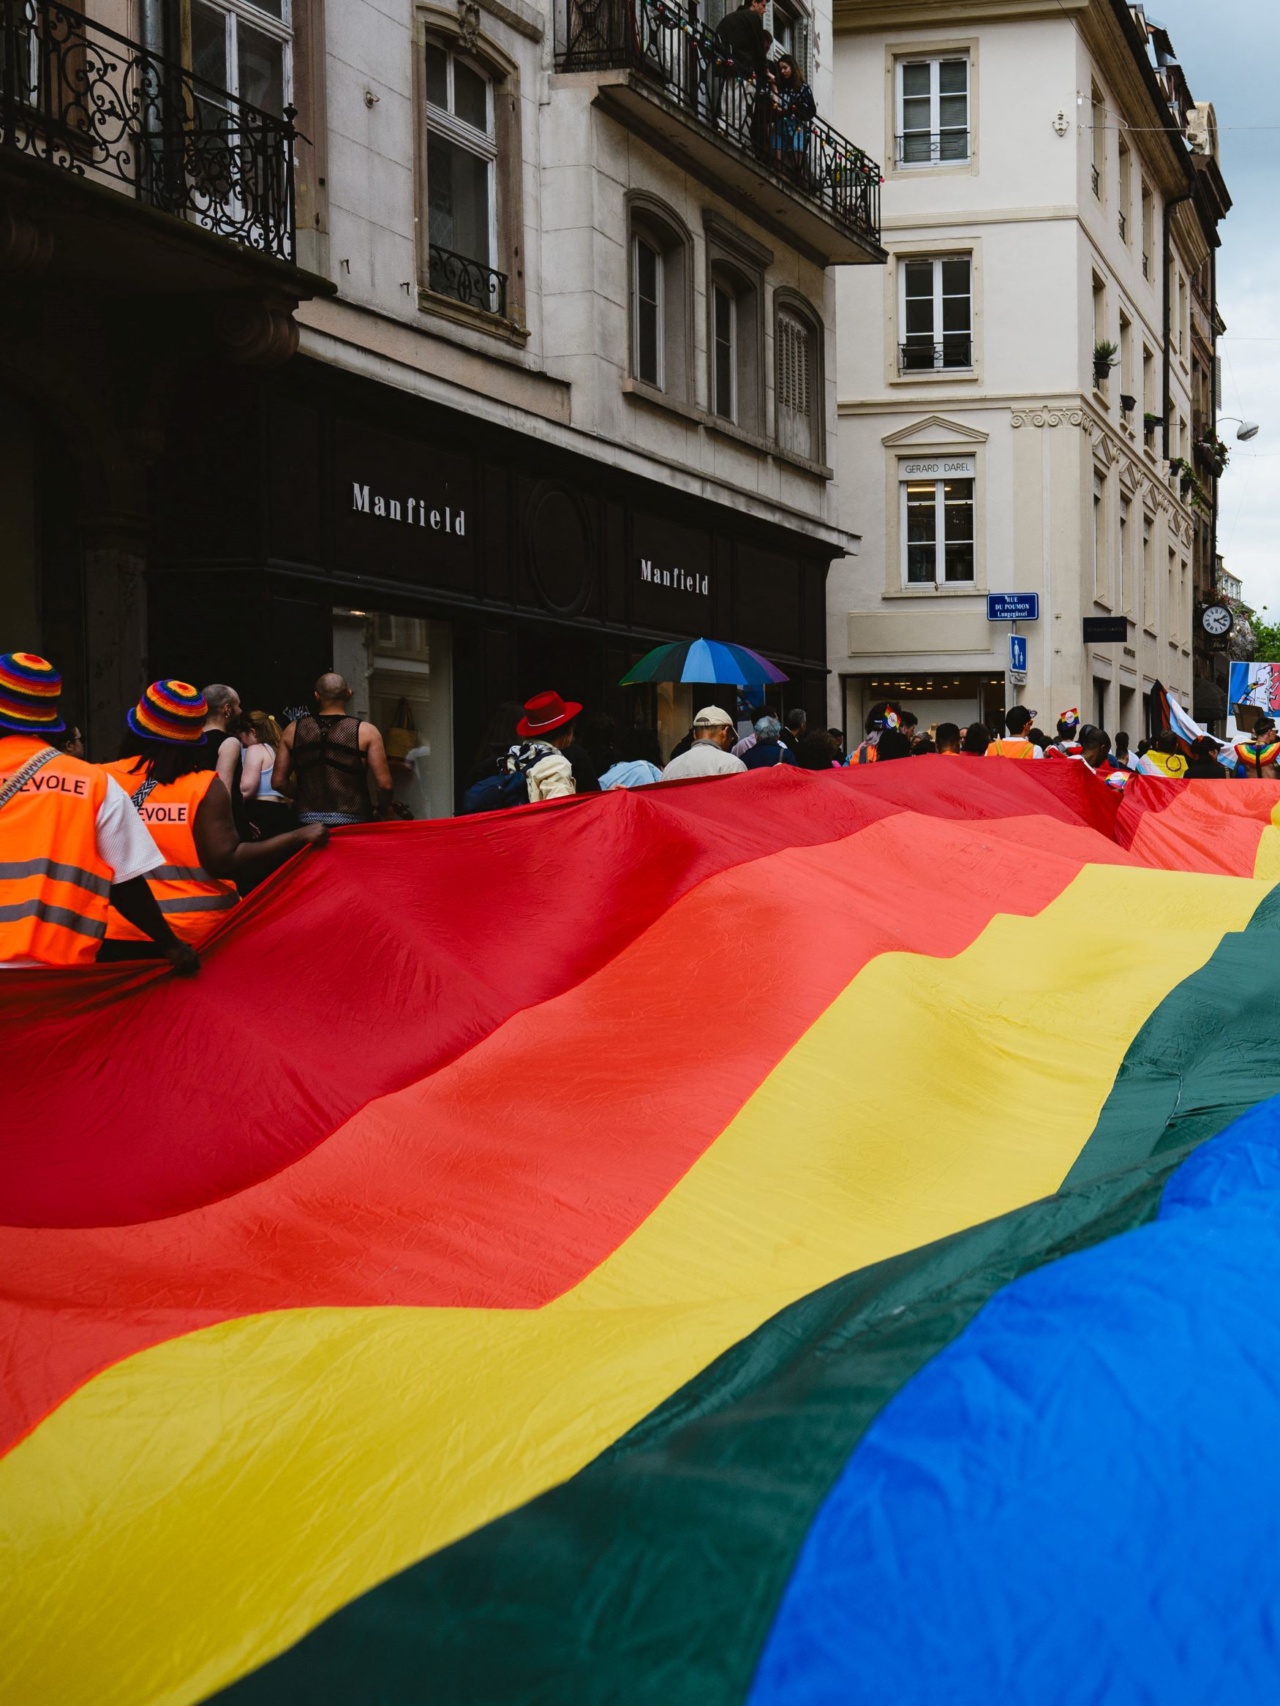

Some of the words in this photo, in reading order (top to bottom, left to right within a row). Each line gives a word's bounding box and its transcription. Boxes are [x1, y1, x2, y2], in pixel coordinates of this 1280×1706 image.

[905, 464, 939, 474] GERARD
[944, 463, 970, 472] DAREL
[352, 481, 465, 536] Manfield
[641, 558, 708, 595] Manfield
